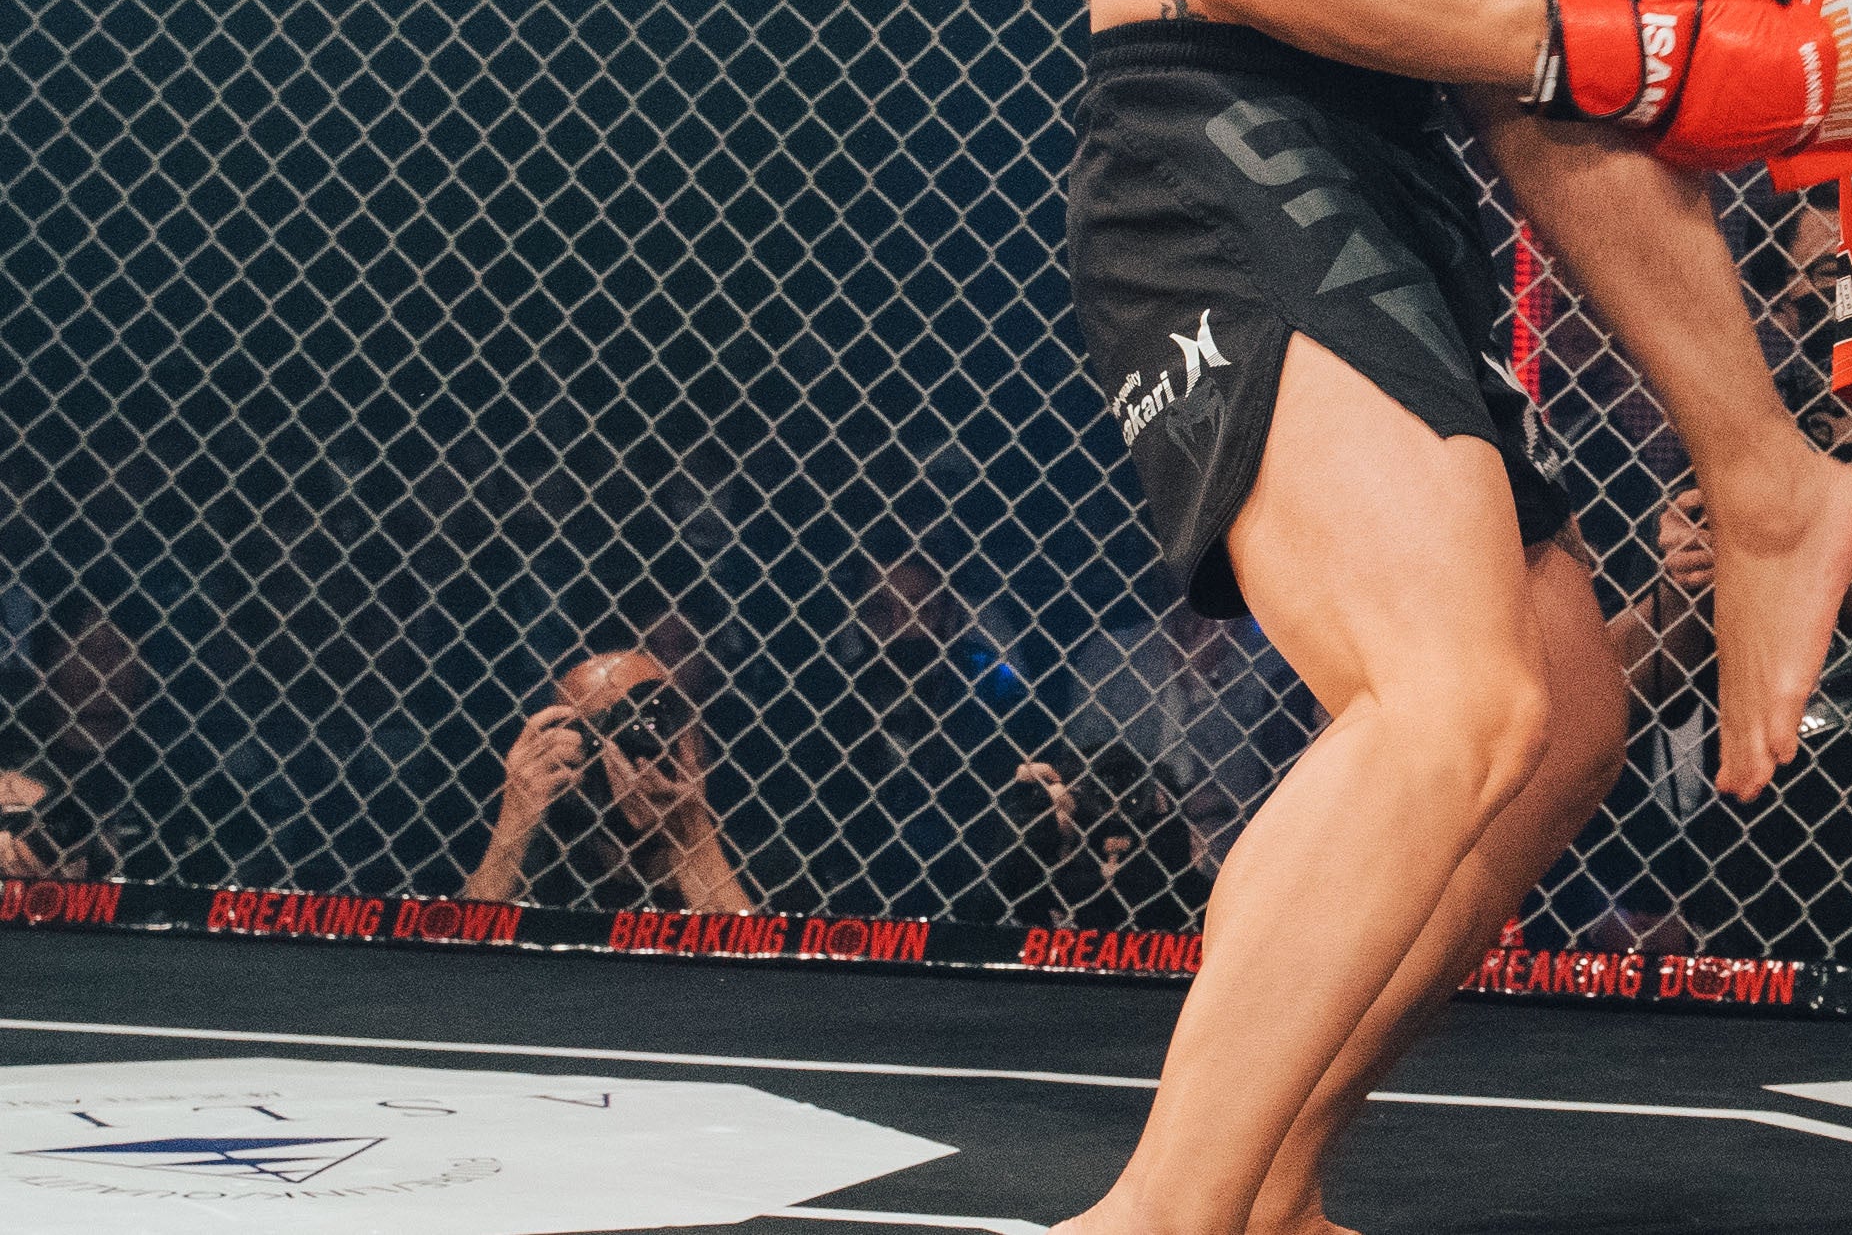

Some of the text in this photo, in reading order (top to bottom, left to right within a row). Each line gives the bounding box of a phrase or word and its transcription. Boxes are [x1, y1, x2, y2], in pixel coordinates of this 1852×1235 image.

[0, 878, 122, 925] DOWN
[207, 888, 523, 943] BREAKING DOWN
[608, 910, 931, 962] BREAKING DOWN
[1658, 954, 1799, 1005] DOWN
